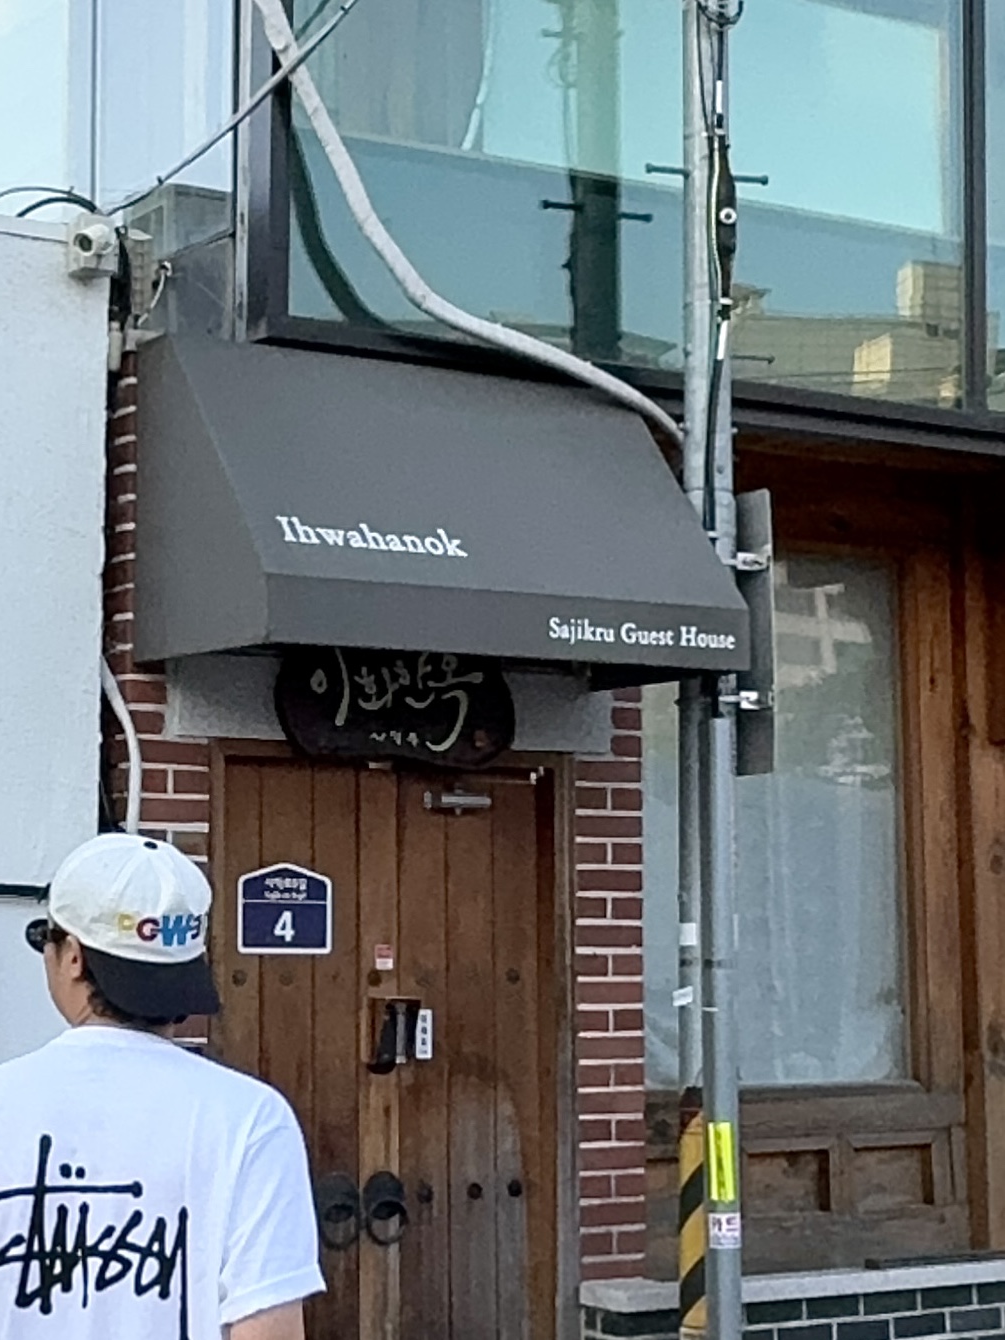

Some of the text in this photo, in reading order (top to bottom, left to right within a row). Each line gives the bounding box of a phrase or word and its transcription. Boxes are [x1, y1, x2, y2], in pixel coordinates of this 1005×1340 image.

[275, 515, 469, 558] Ihwahanok
[549, 617, 736, 650] Sajikru Guest House
[273, 910, 295, 942] 4
